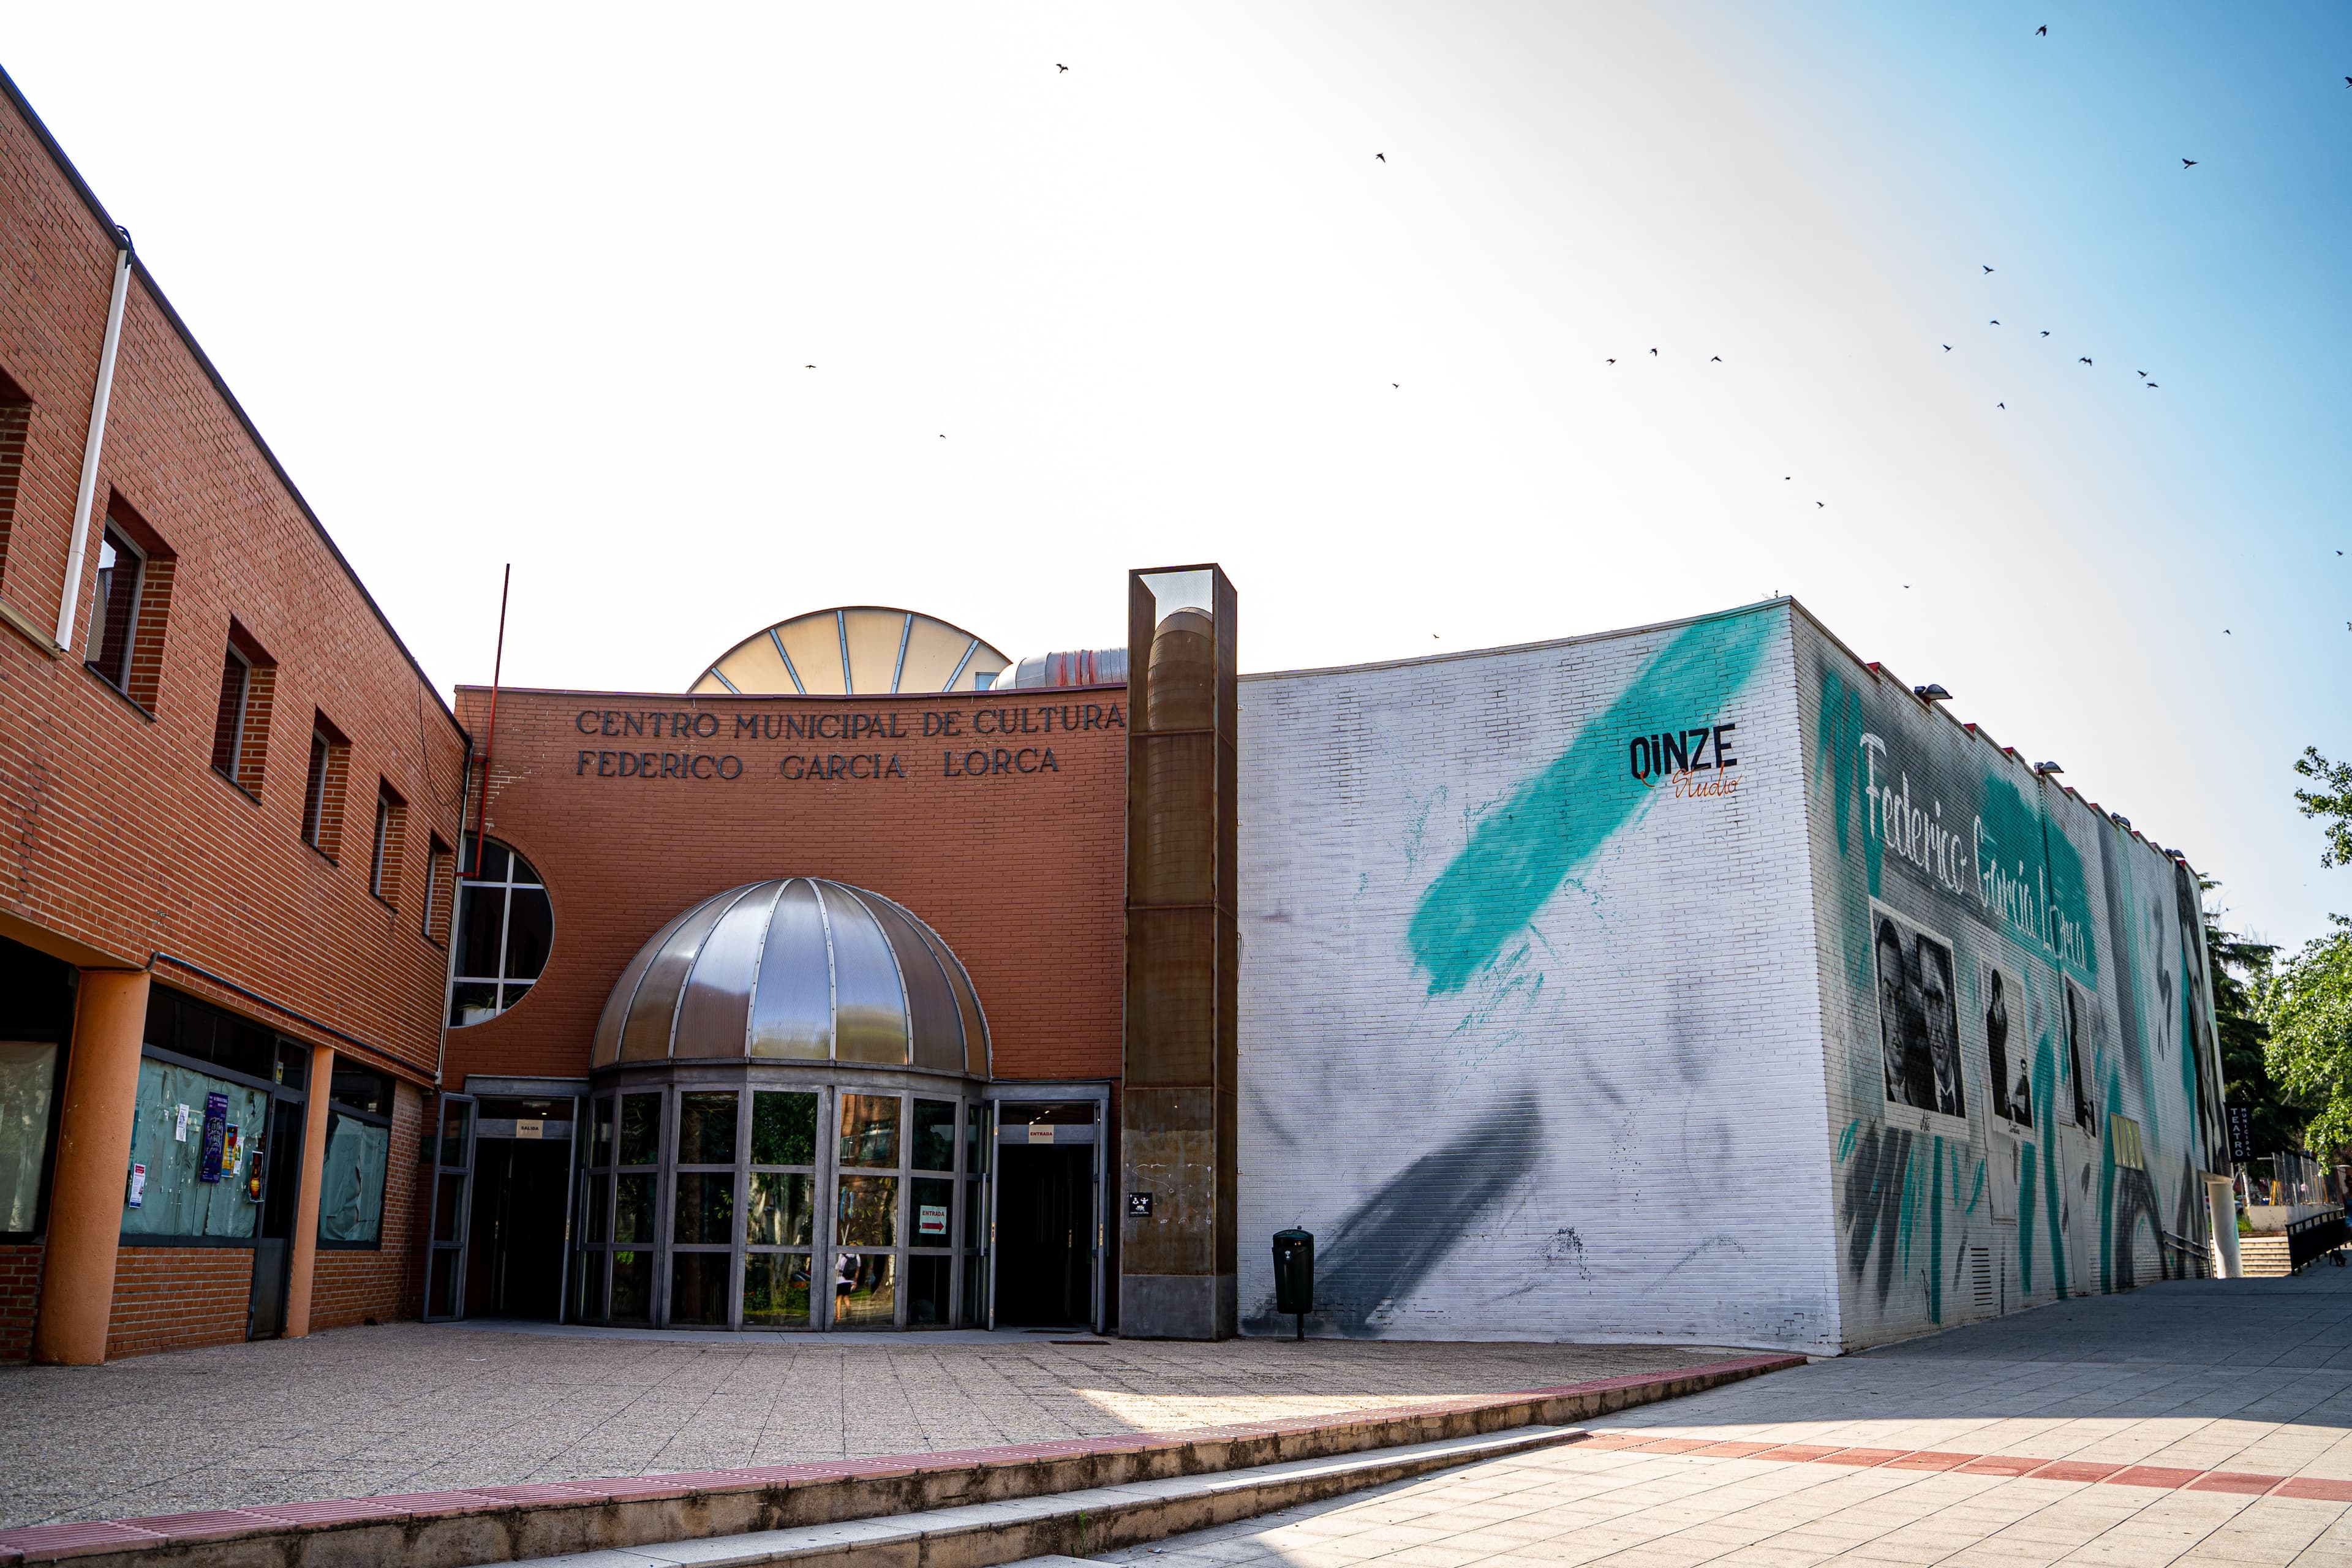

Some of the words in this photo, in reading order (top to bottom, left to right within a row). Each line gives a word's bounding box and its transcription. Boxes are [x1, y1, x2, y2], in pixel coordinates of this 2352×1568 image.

[576, 710, 719, 738] CENTRO
[734, 713, 907, 739] MUNICIPAL
[922, 711, 960, 737] DE
[973, 703, 1125, 734] CULTURA
[577, 750, 743, 779] FEDERICO
[780, 753, 905, 780] GARCIA
[944, 747, 1059, 776] LORCA
[1672, 761, 1743, 799] Studio
[1860, 733, 1967, 895] Federico
[2230, 1108, 2243, 1156] TEATRO
[2241, 1107, 2251, 1156] MUNICIPAL
